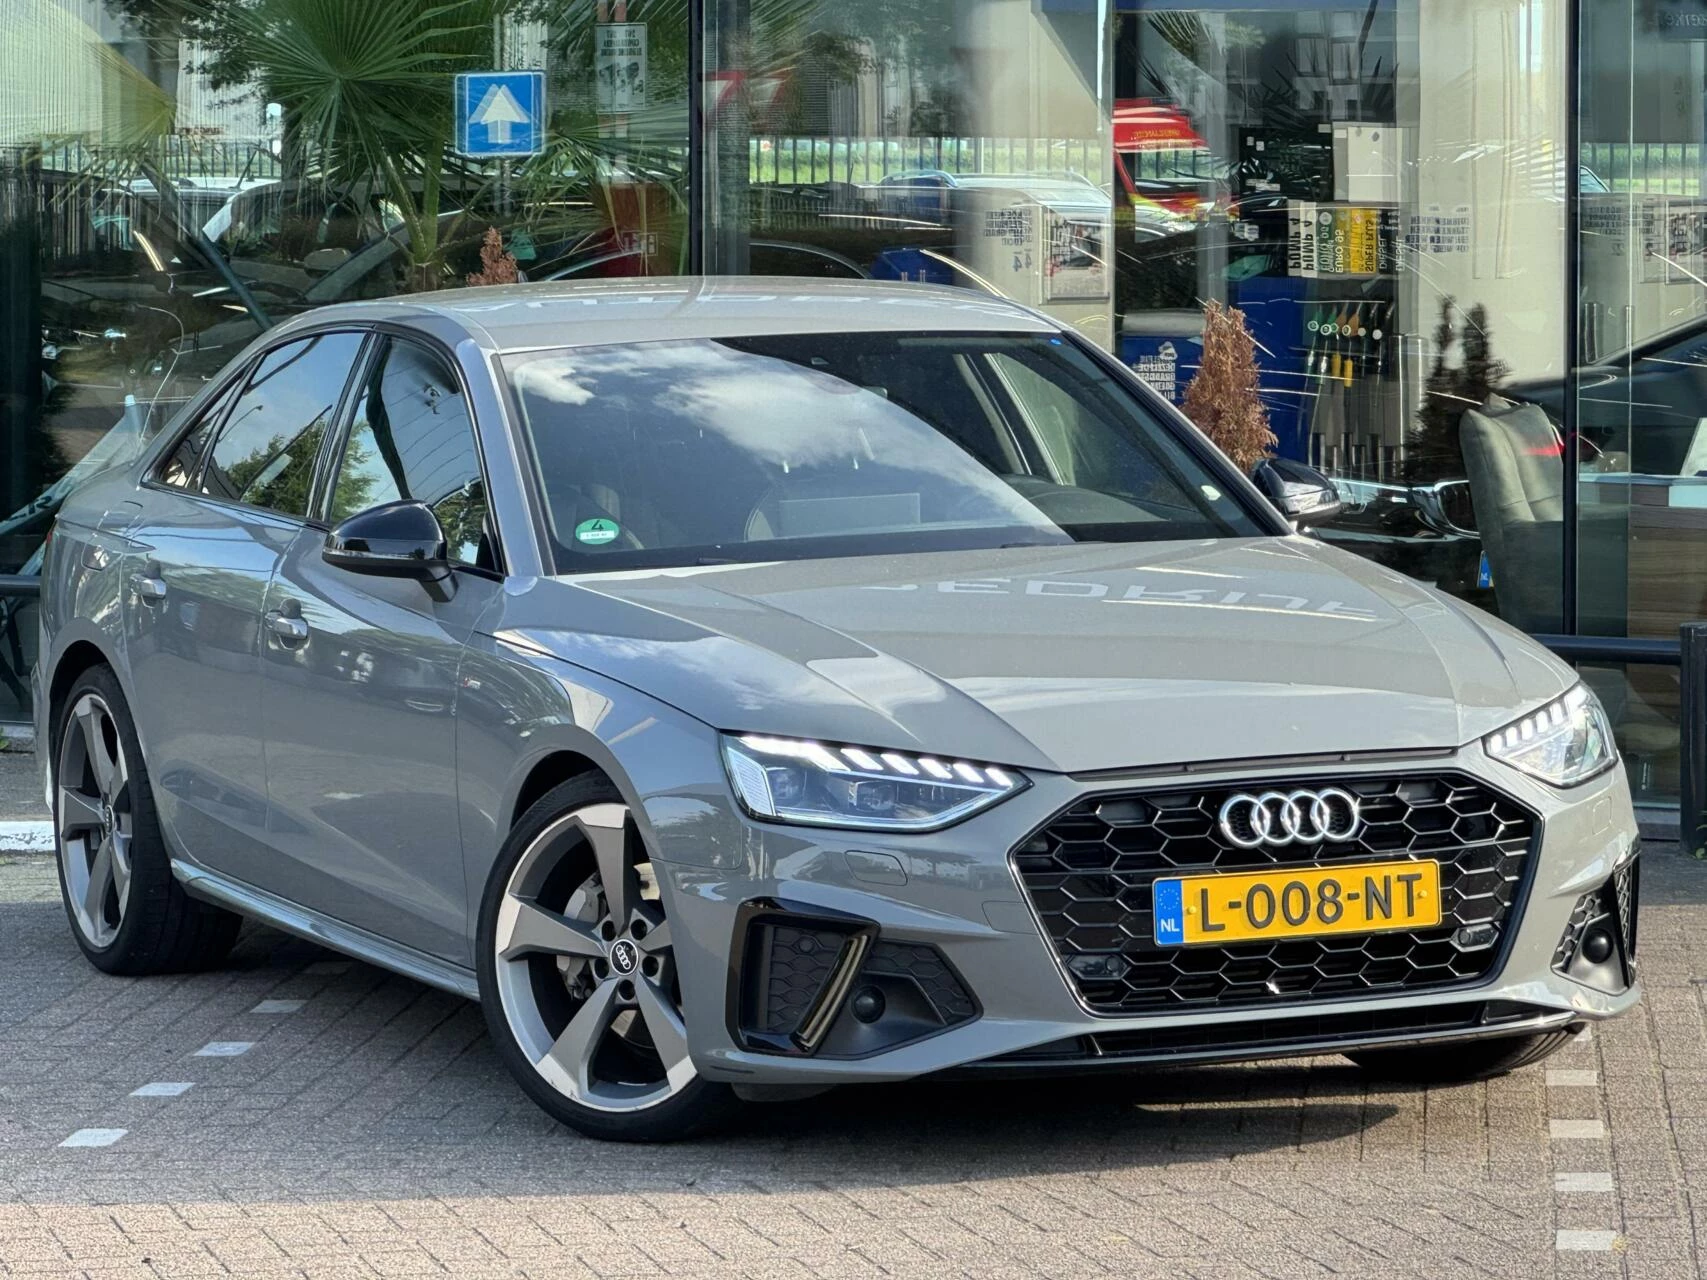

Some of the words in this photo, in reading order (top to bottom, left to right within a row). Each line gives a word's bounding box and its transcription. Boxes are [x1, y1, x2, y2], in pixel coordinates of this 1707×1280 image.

[591, 519, 605, 531] 4
[1200, 873, 1423, 932] L-008-NT
[1160, 918, 1180, 932] NL
